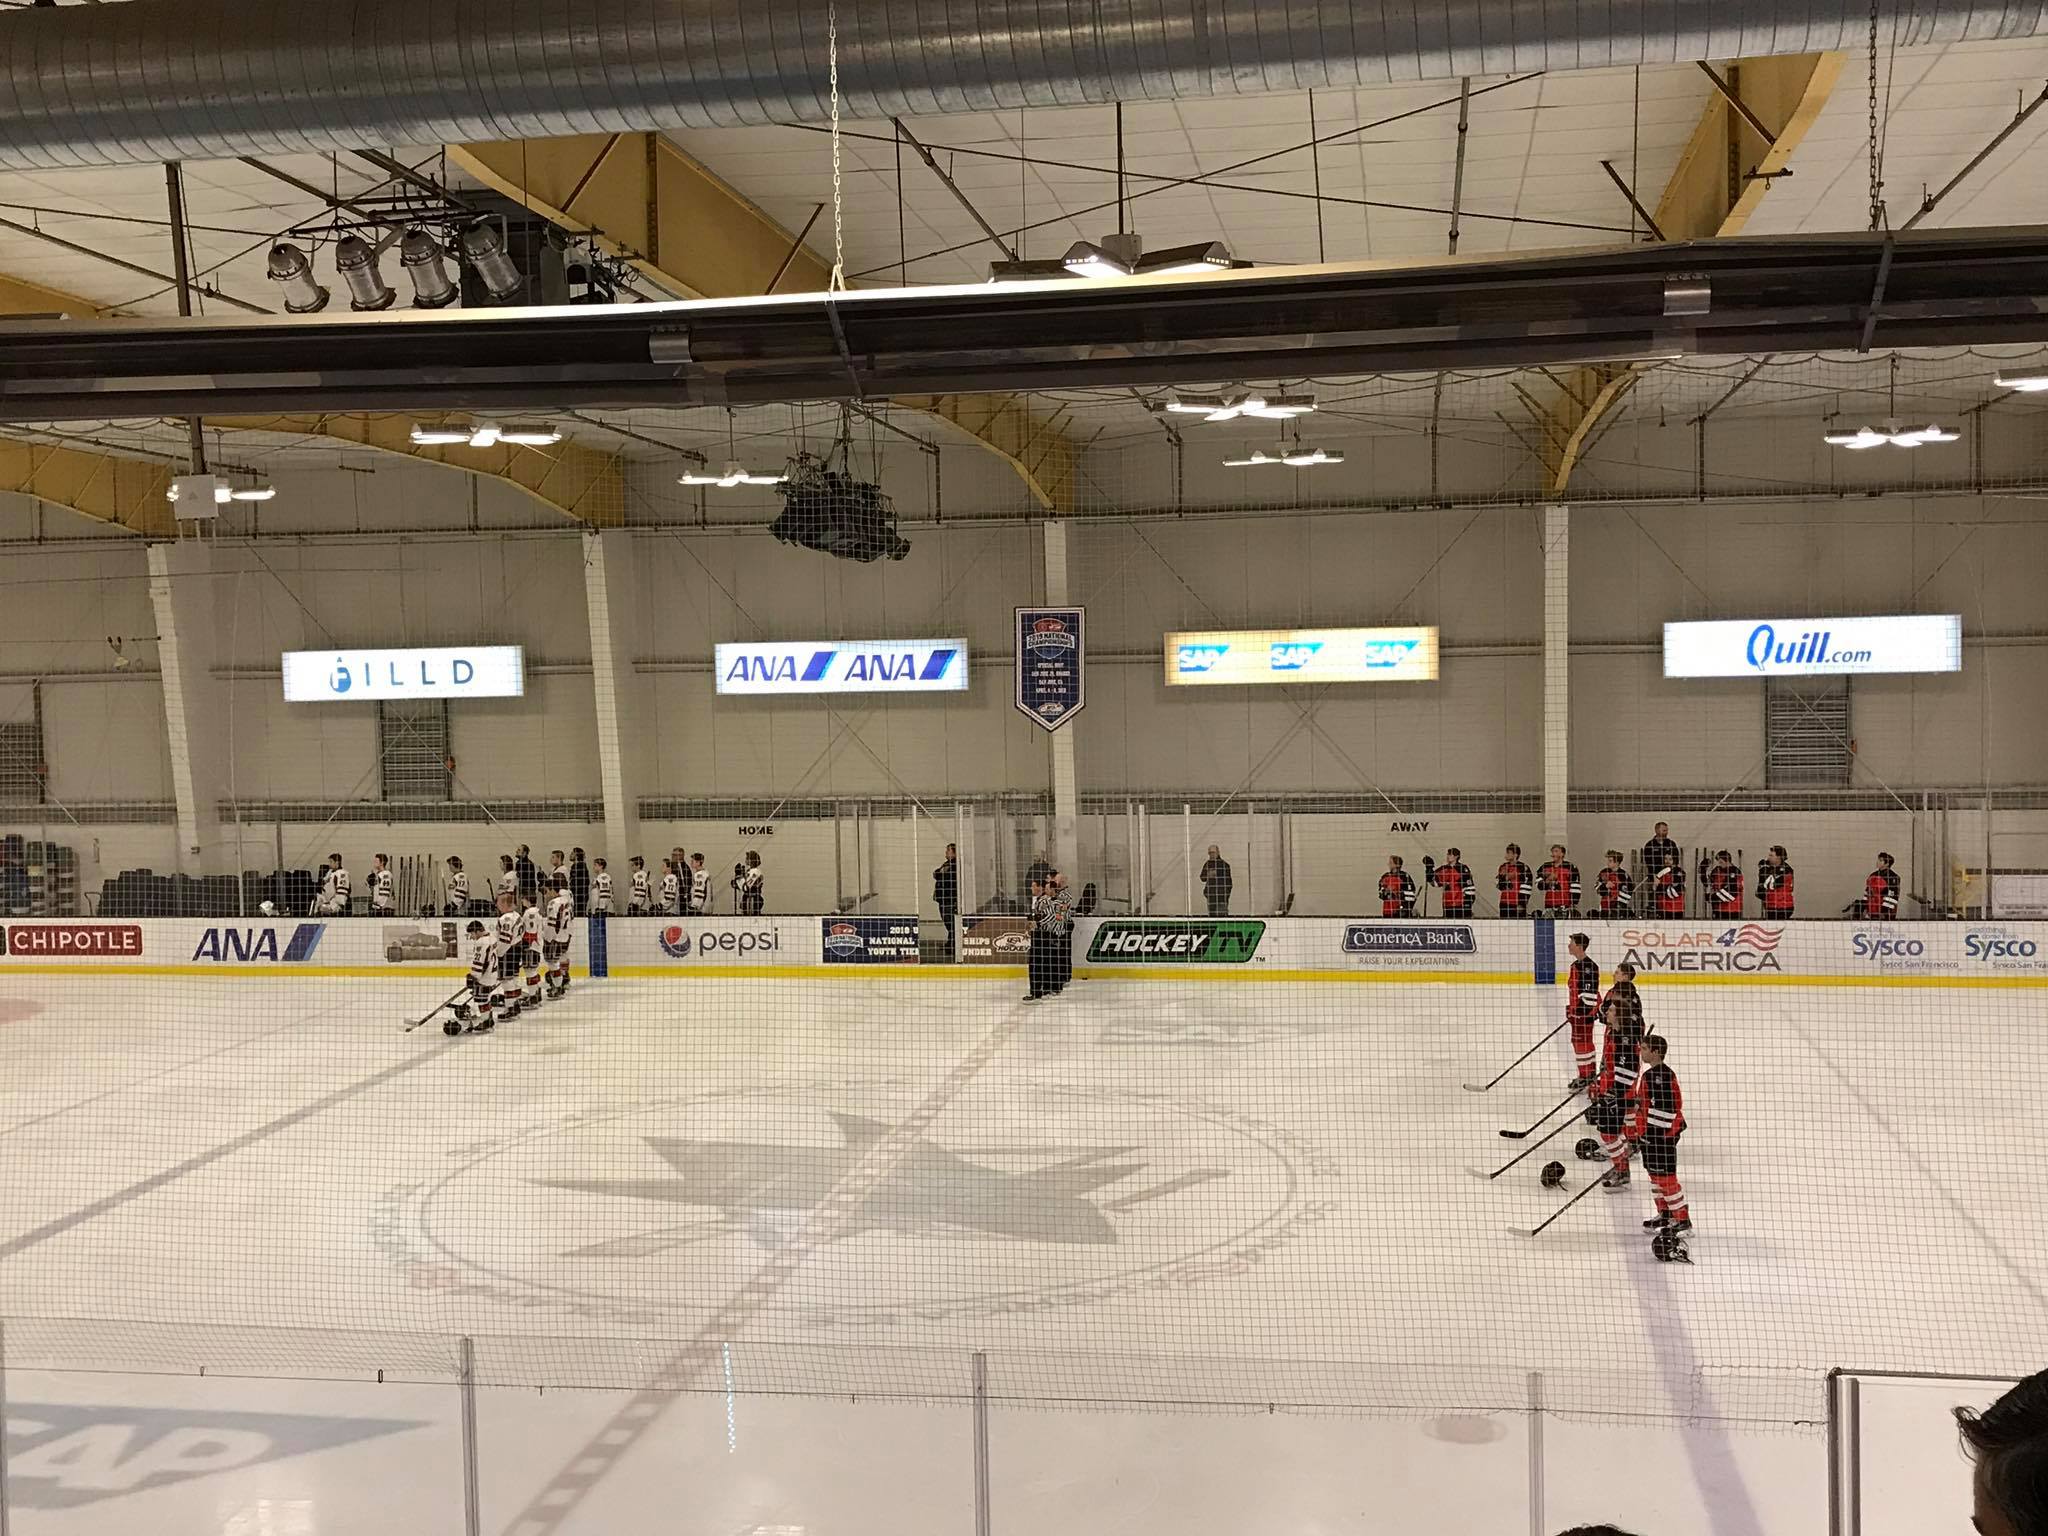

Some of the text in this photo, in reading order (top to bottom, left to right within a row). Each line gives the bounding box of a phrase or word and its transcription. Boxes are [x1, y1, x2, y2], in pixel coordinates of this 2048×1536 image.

[1746, 624, 1872, 671] Quill.com
[726, 654, 916, 681] ANA ANA
[738, 825, 774, 835] HOME
[1390, 821, 1429, 832] AWAY
[14, 931, 136, 951] CHIPOTLE
[192, 928, 279, 961] ANA
[699, 927, 779, 957] pepsi
[869, 937, 915, 945] NATIONAL
[1426, 931, 1464, 945] Bank
[1716, 928, 1738, 947] 4
[1853, 933, 1924, 960] Sysco
[1965, 934, 2037, 961] Sysco
[867, 947, 897, 956] YOUTH
[1360, 957, 1460, 965] RAISE YOUR EXPECTATIONS
[1622, 949, 1782, 971] AMERICA
